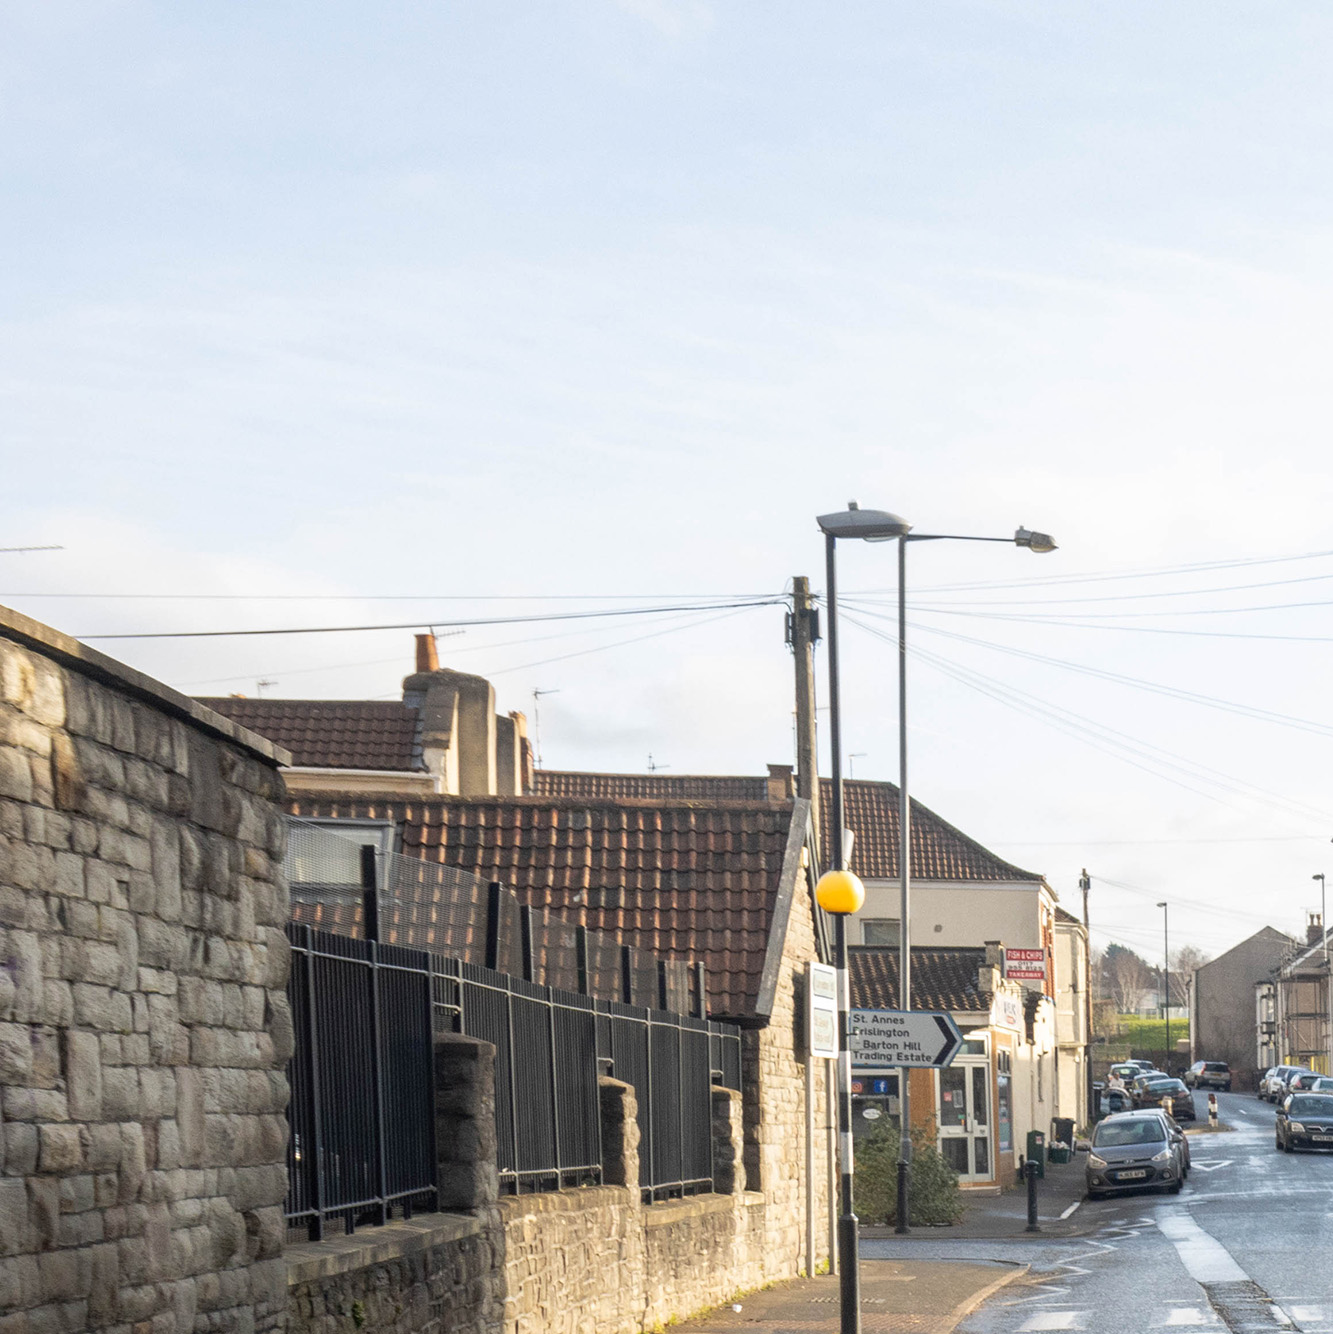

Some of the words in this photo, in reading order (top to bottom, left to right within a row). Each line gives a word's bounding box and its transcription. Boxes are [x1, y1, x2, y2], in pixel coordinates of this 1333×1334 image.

[1007, 950, 1020, 959] FISH
[1021, 951, 1026, 959] &
[1026, 951, 1043, 960] CHIPS
[853, 1014, 868, 1023] St.
[871, 1015, 905, 1025] Annes
[863, 1040, 899, 1050] Barton
[903, 1041, 922, 1051] Hill
[853, 1051, 893, 1061] Trading
[896, 1053, 932, 1062] Estate
